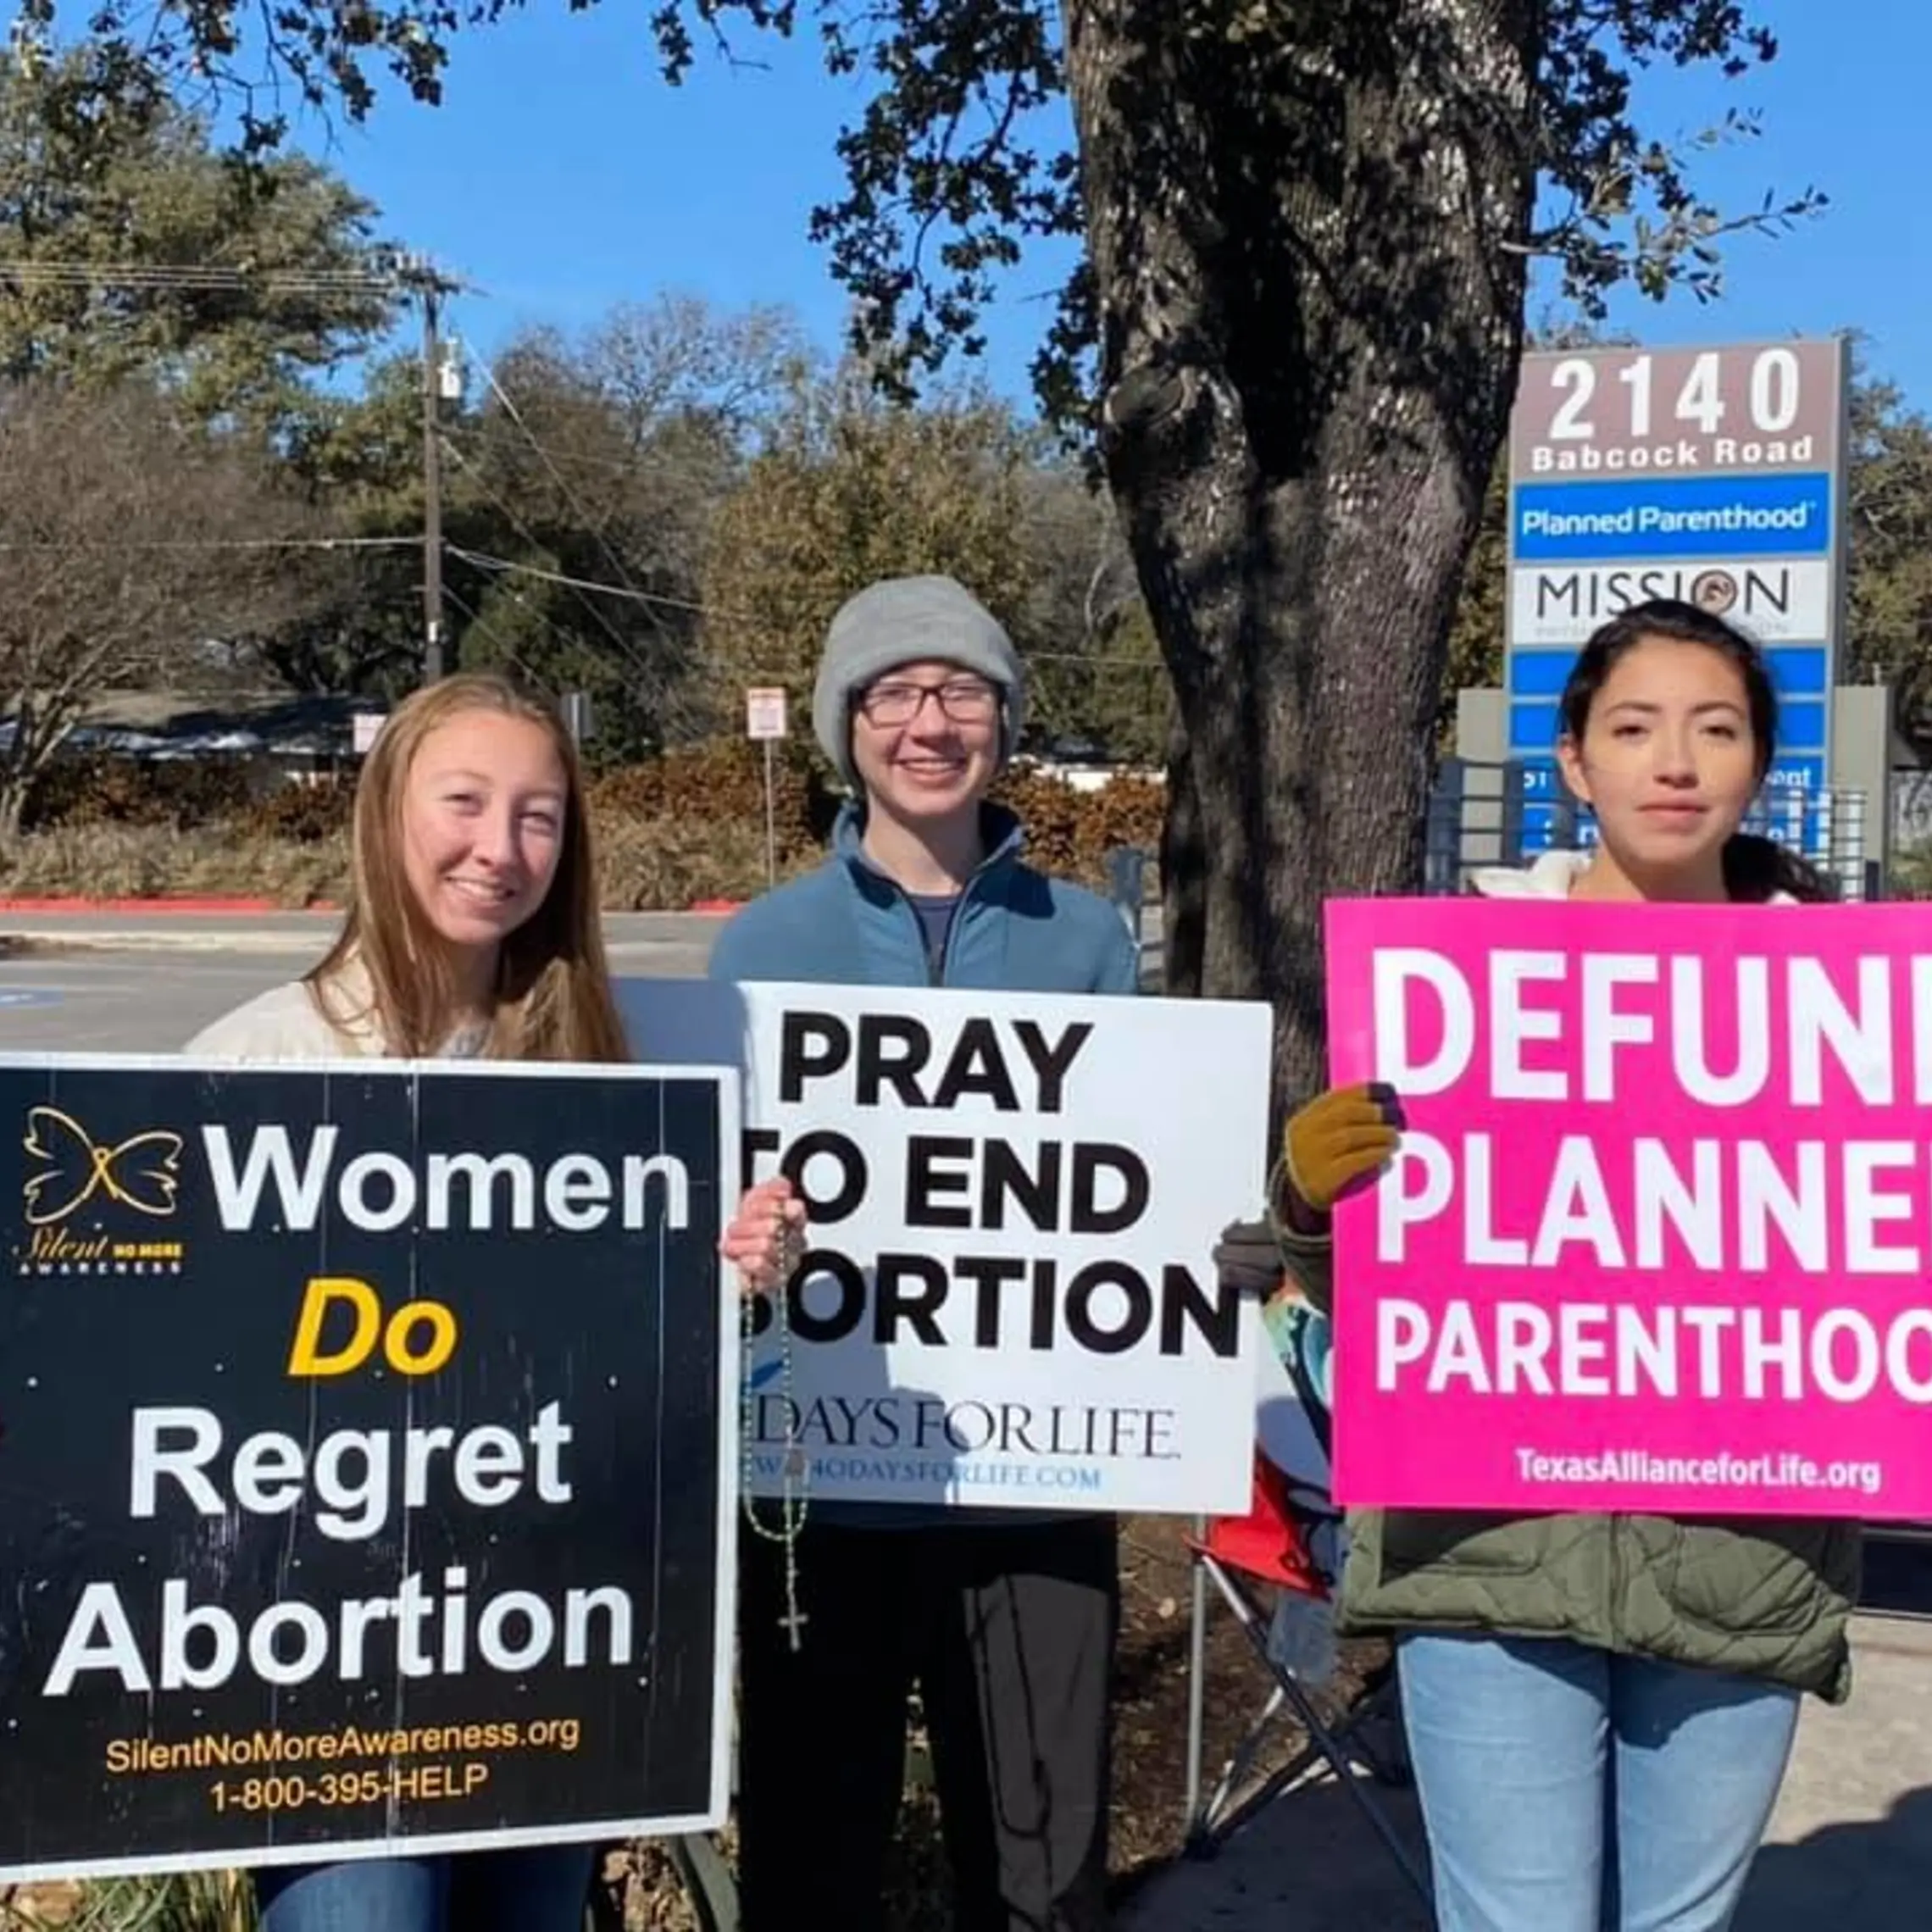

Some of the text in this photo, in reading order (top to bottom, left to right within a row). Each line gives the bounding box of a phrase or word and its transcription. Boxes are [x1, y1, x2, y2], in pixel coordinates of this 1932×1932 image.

[1550, 348, 1800, 439] 2140
[1532, 436, 1813, 472] Babcock Road
[1523, 501, 1807, 535] Planned Parenthood
[1537, 569, 1788, 618] MISSION
[780, 1011, 1094, 1113] PRAY
[1373, 948, 1932, 1107] DEFUN
[202, 1124, 689, 1232] Women
[905, 1135, 1150, 1235] END
[1377, 1130, 1932, 1274] PLANNE
[28, 1226, 108, 1259] Silent
[286, 1279, 458, 1376] Do
[741, 1248, 1239, 1357] ORTION
[130, 1400, 572, 1540] Regret
[753, 1394, 1181, 1459] DAYS FOR LIFE
[1517, 1448, 1881, 1493] TexasAllianceforLife.org
[42, 1568, 633, 1695] Abortion
[106, 1718, 580, 1773] SilentNoMoreAwareness.org
[210, 1764, 489, 1812] 1-800-395-HELP
